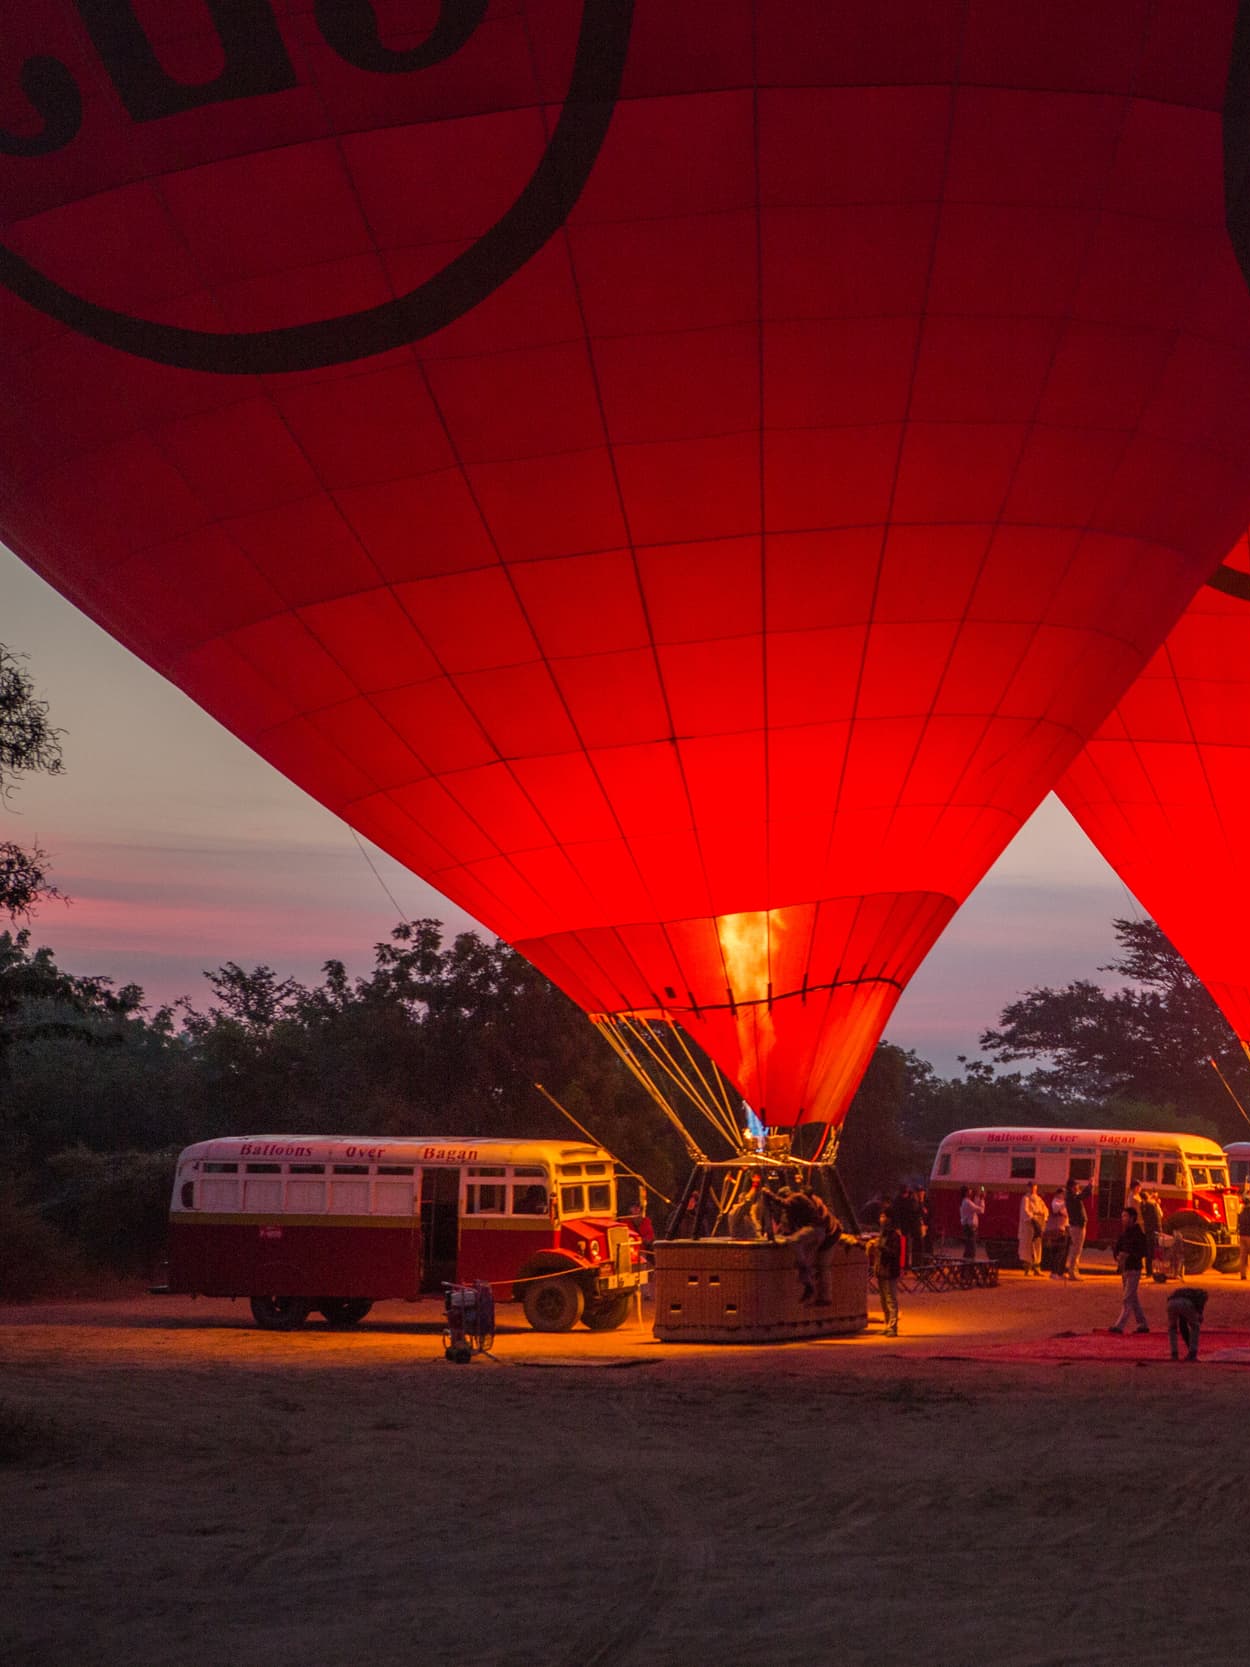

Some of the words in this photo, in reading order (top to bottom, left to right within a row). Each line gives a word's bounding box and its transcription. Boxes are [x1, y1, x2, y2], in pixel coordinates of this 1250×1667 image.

[239, 1143, 313, 1157] Balloons
[345, 1145, 386, 1159] Over
[423, 1147, 479, 1163] Bagan
